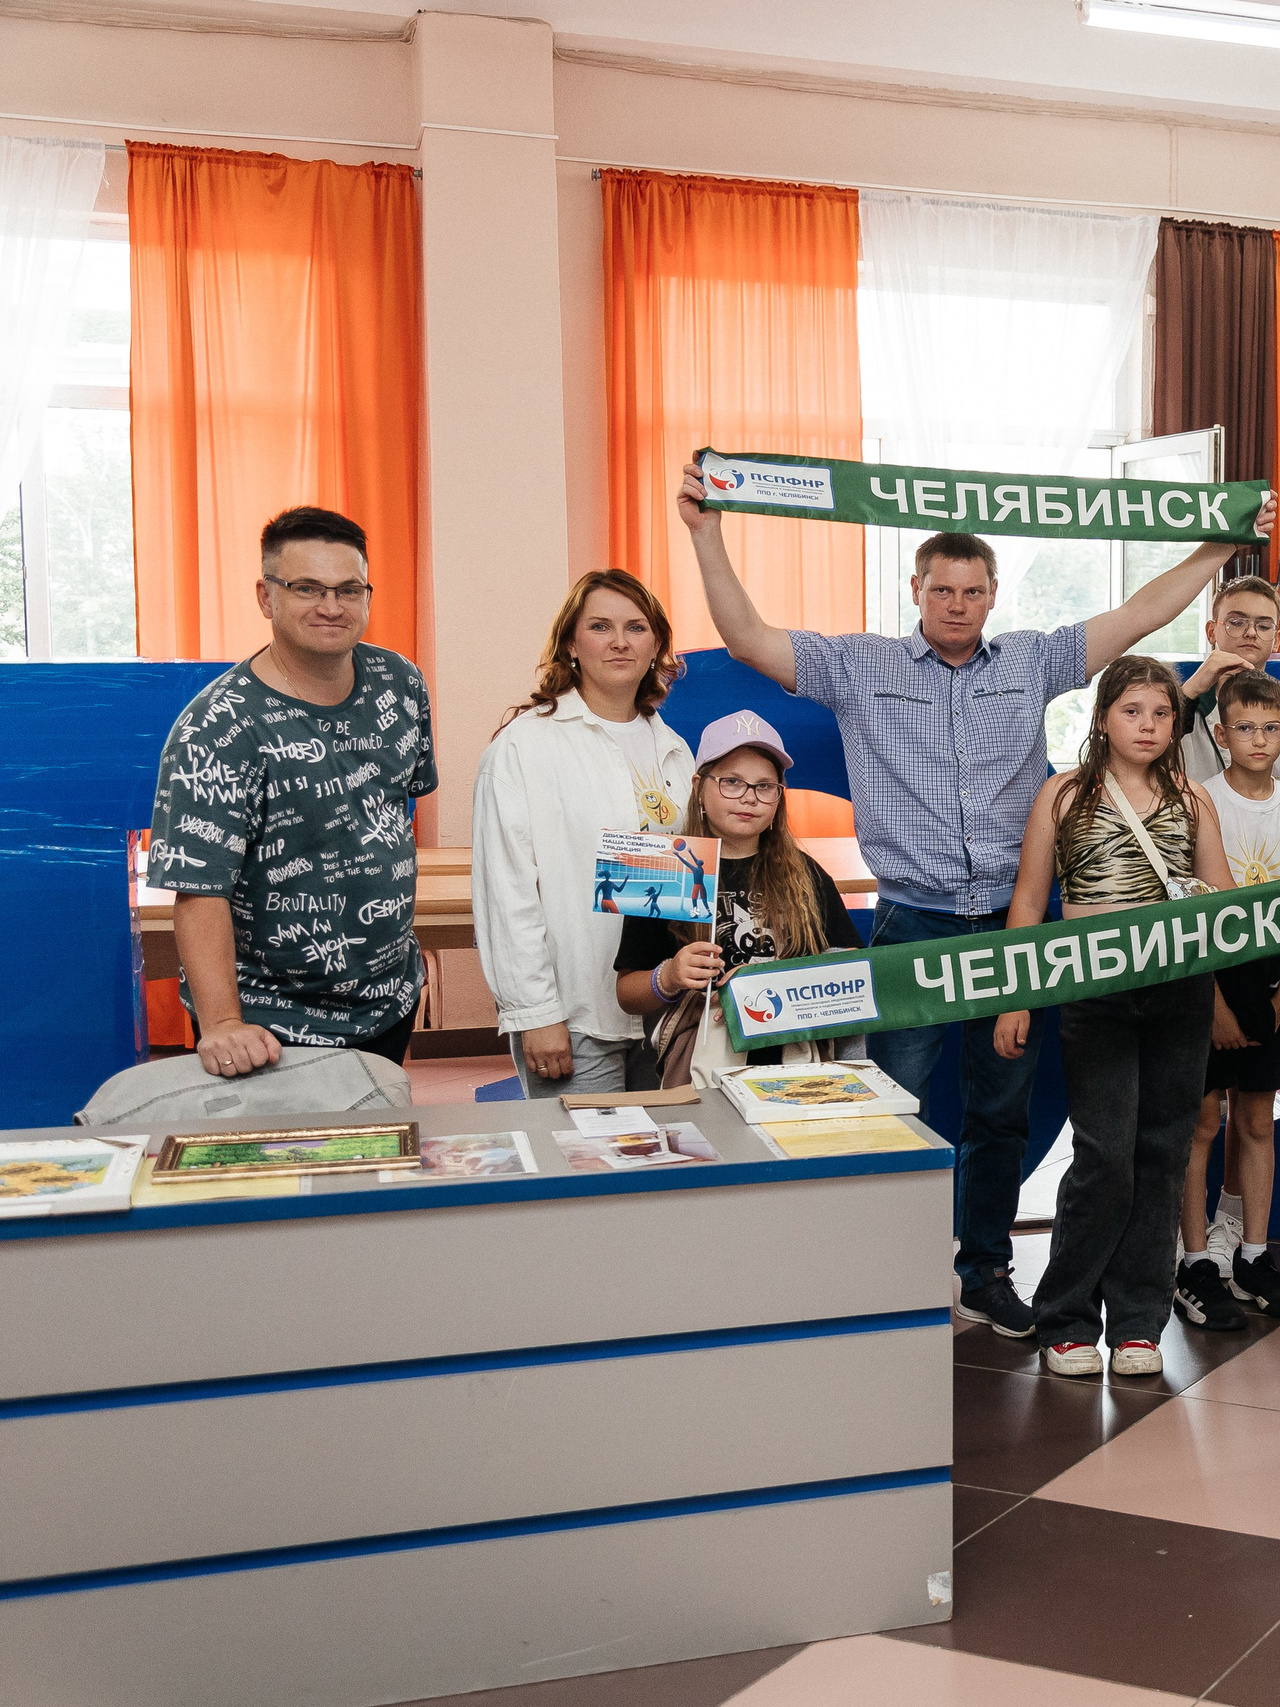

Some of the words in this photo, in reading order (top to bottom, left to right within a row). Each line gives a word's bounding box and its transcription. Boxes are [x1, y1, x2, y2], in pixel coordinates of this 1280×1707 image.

[750, 472, 825, 488] ПСПФНР
[779, 492, 820, 500] ЧЕЛЯБИНСК
[870, 477, 1230, 531] ЧЕЛЯБИНСК
[375, 689, 398, 713] FEAR
[262, 711, 287, 724] YOUNG
[376, 708, 399, 732] LESS
[317, 718, 332, 732] TO
[336, 720, 351, 735] BE
[213, 723, 243, 748] READY
[283, 779, 291, 792] A
[295, 776, 309, 790] IS
[315, 777, 344, 799] LIFE
[602, 832, 644, 841] ДВИЖЕНИЕ
[602, 845, 641, 853] ТРАДИЦИЯ
[626, 840, 667, 849] СЕМЕЙНАЯ
[320, 851, 339, 860] WHAT
[323, 862, 340, 871] DOES
[355, 852, 375, 864] MEAN
[335, 870, 345, 879] BE
[346, 867, 361, 876] THE
[165, 880, 200, 890] HOLDING
[266, 892, 346, 916] BRUTALITY
[786, 978, 866, 1002] ПСПФНР
[239, 990, 273, 1005] READY
[277, 998, 294, 1010] I'M
[304, 1005, 328, 1019] YOUNG
[797, 1012, 813, 1020] ППО
[820, 1006, 862, 1017] ЧЕЛЯБИНСК
